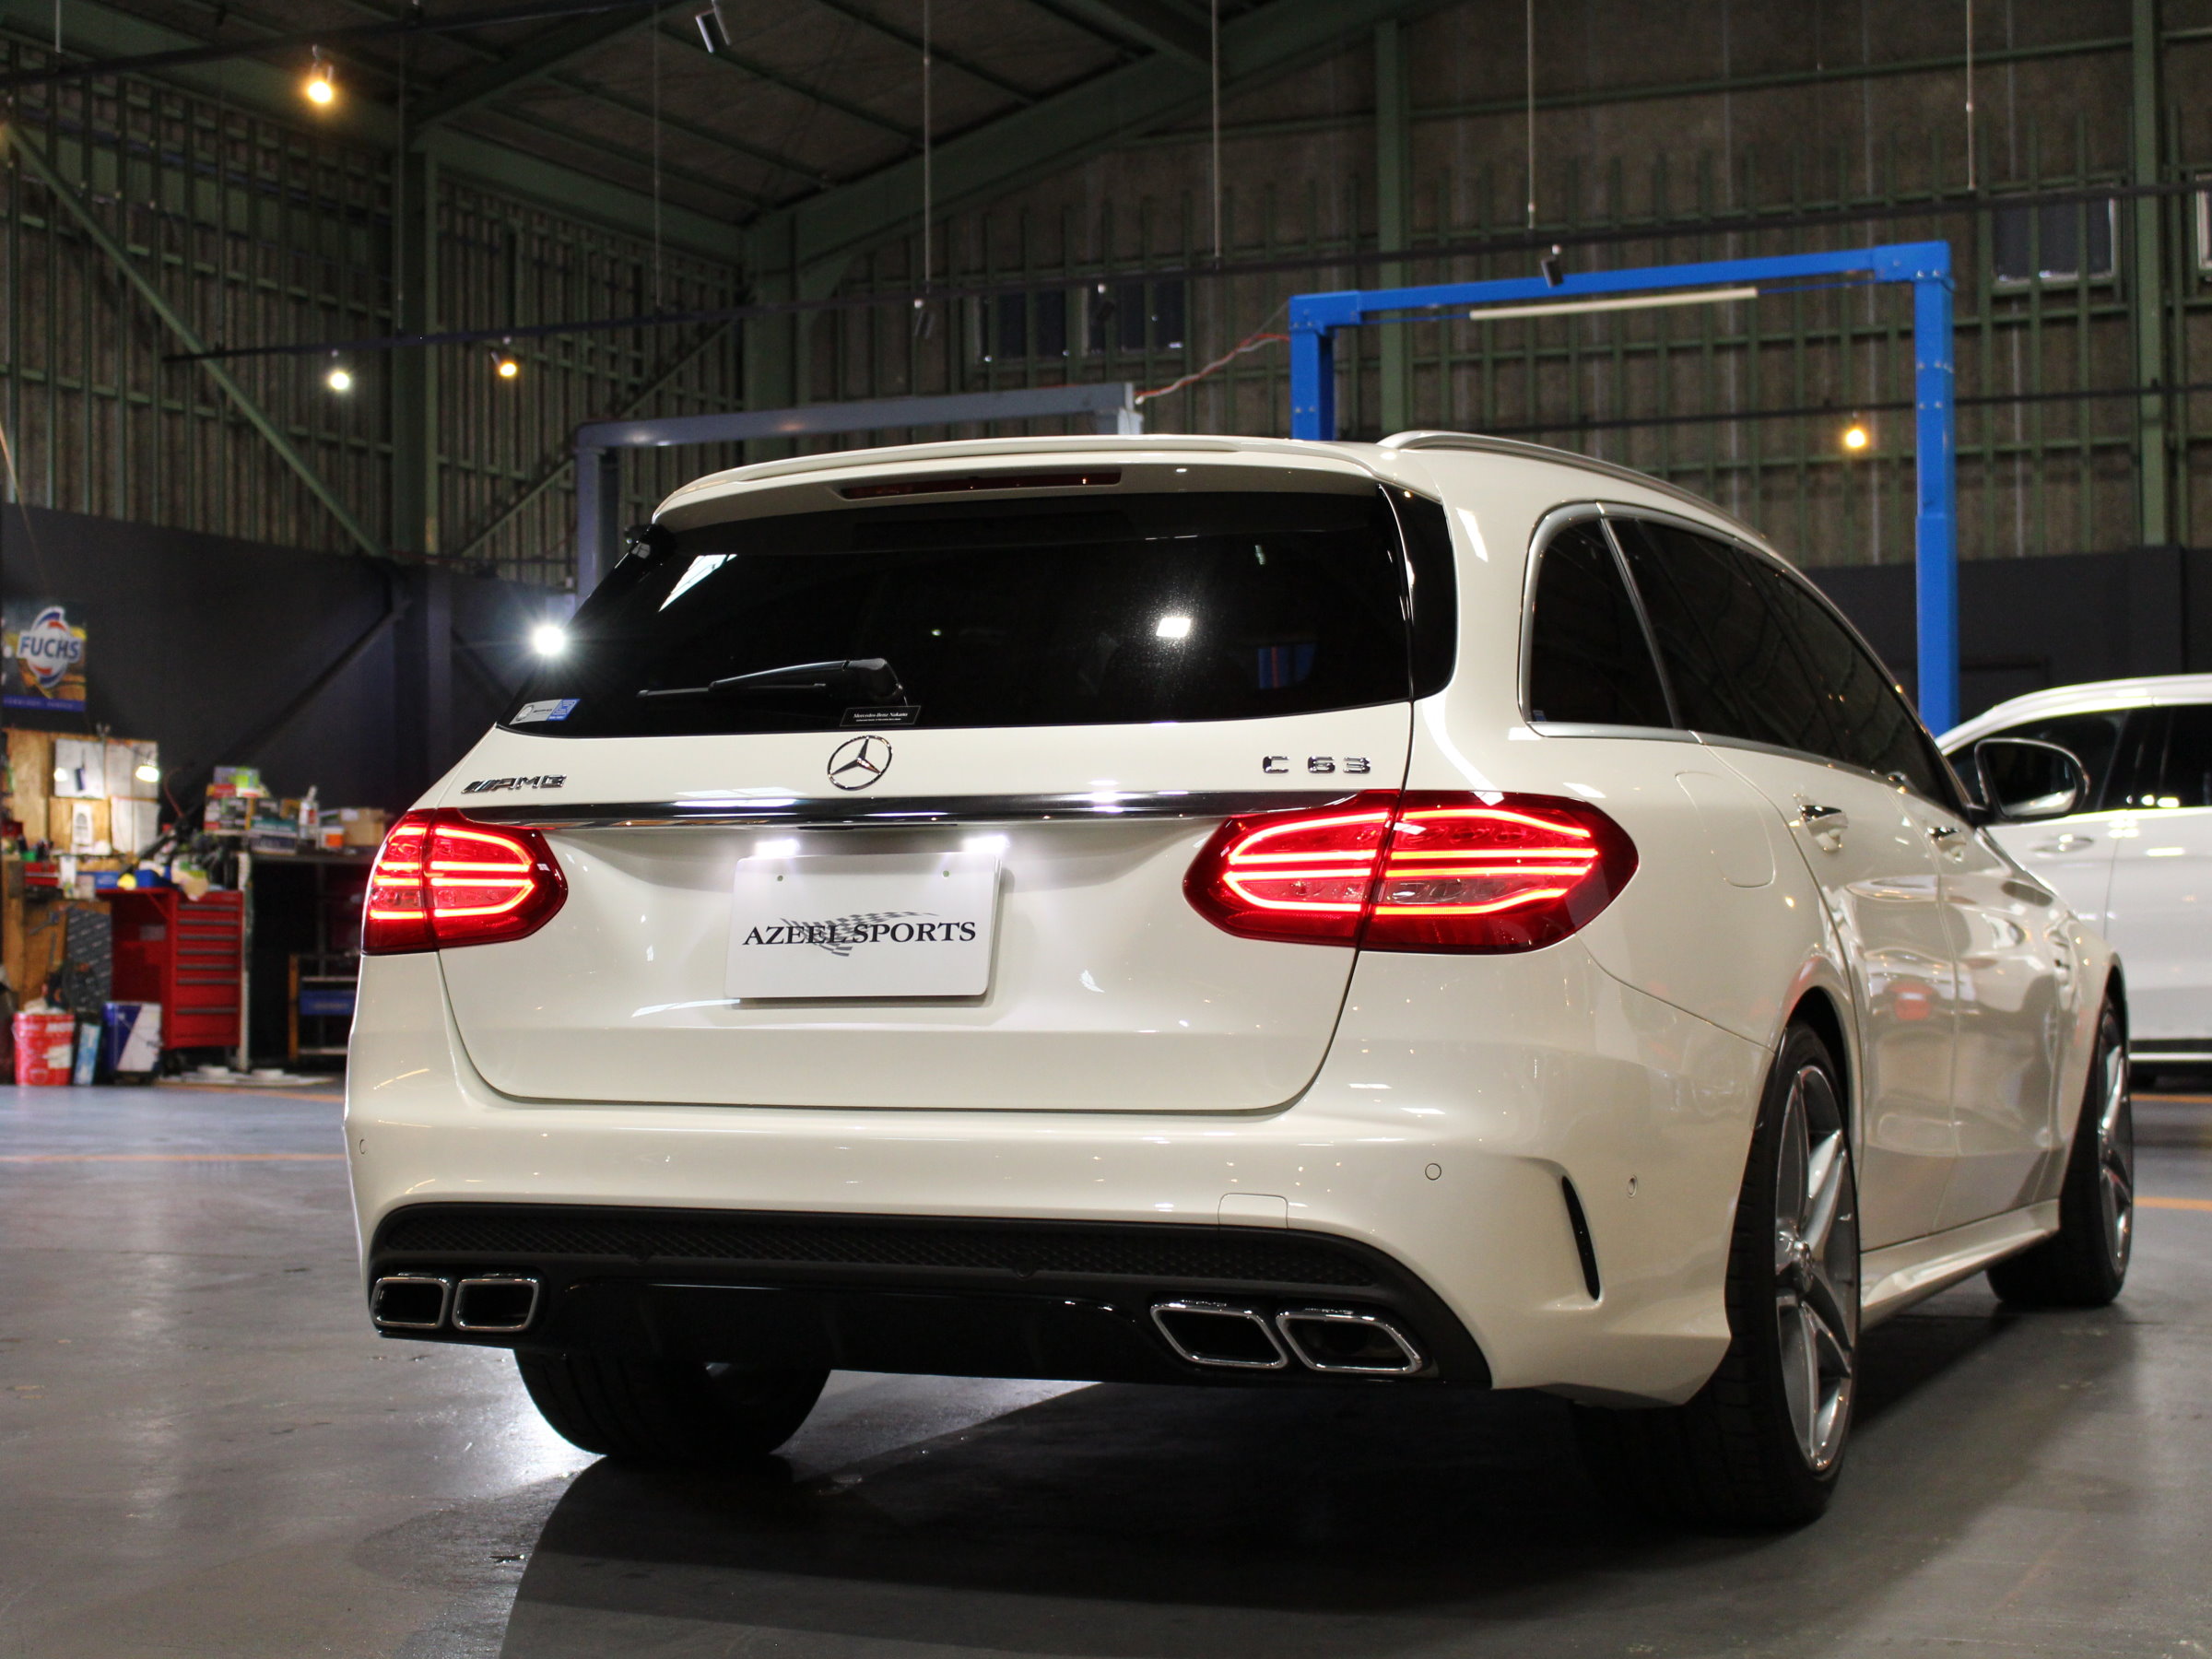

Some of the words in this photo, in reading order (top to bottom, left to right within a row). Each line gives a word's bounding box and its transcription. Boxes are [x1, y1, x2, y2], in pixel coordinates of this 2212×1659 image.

[20, 636, 79, 660] FUCHS
[1262, 756, 1289, 773] C
[1307, 756, 1371, 774] 63
[488, 773, 568, 792] AMG
[743, 925, 847, 945] AZEEL
[853, 922, 976, 944] SPORTS
